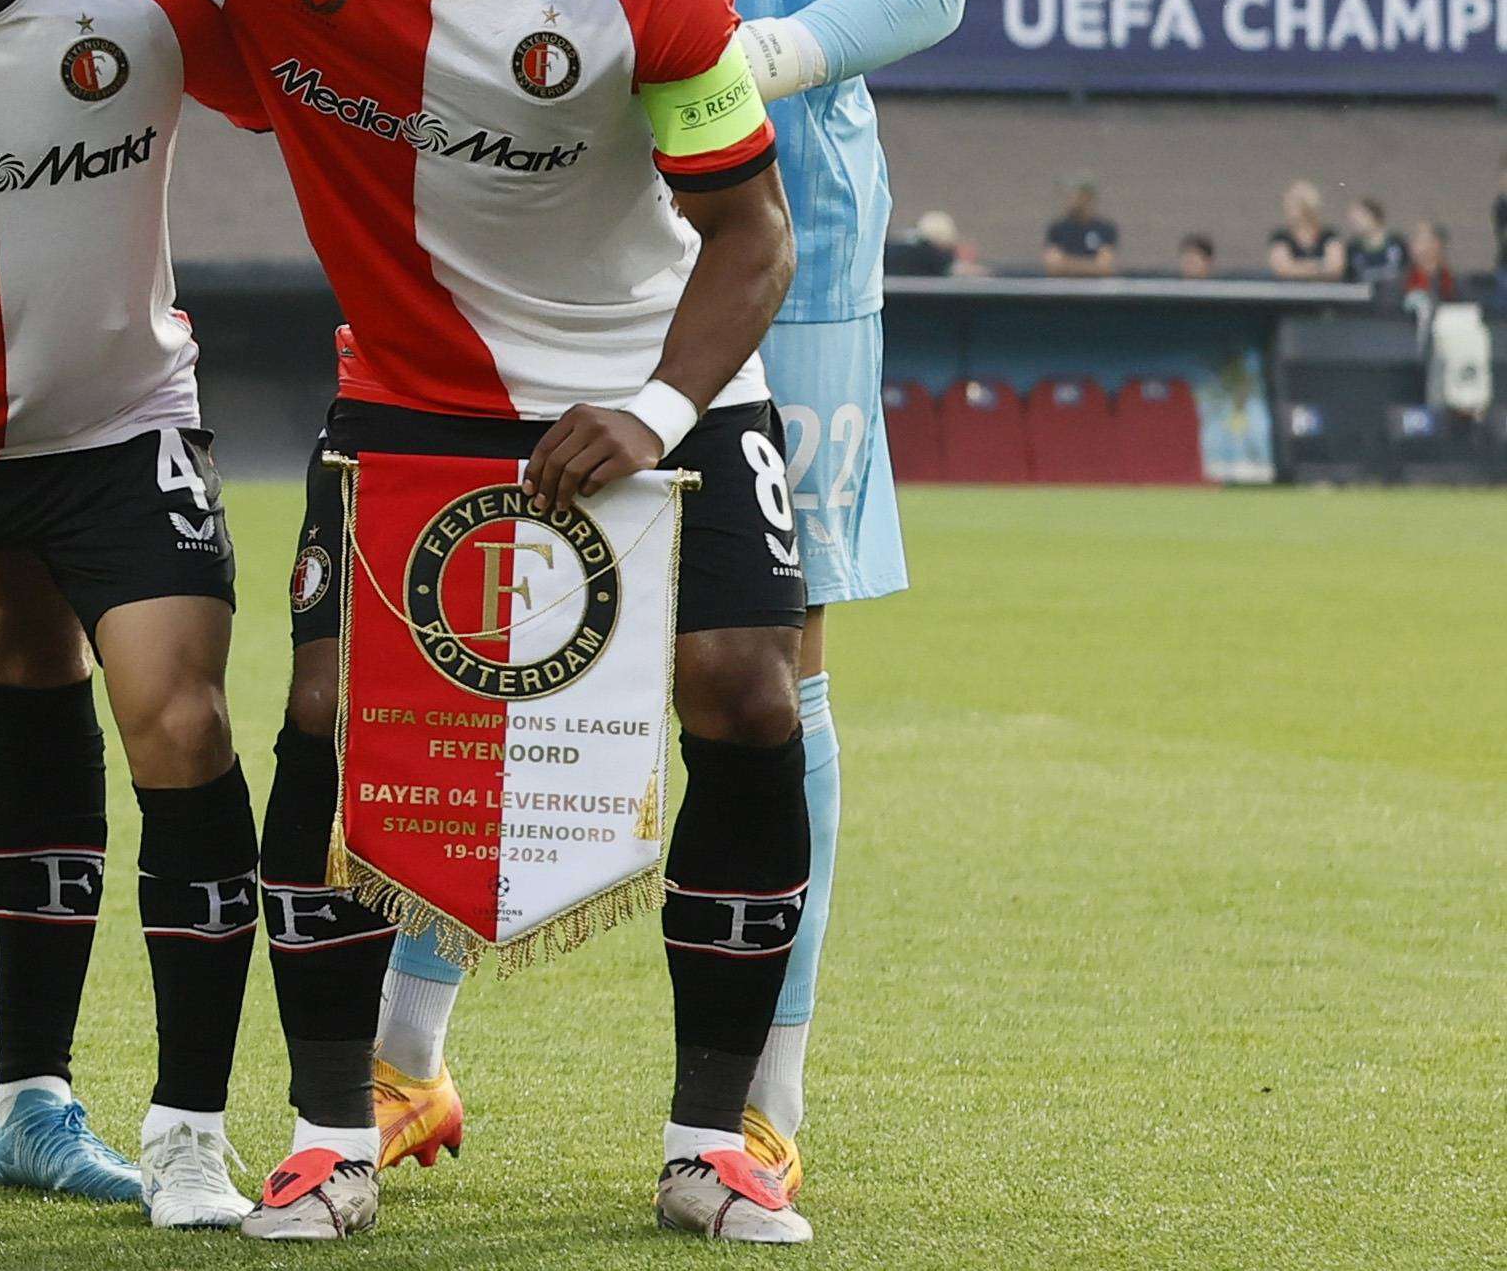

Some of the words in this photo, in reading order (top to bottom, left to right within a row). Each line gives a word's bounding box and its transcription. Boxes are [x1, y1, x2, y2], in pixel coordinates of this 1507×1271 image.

[534, 48, 559, 79] F
[271, 58, 402, 141] Media
[441, 130, 587, 172] Markt
[20, 125, 157, 190] Markt
[157, 427, 209, 510] 4
[741, 431, 793, 531] 8
[778, 403, 865, 509] 22
[424, 493, 605, 563] FEYENOORD
[470, 541, 554, 642] F
[420, 620, 603, 693] ROTTERDAM
[362, 708, 416, 725] UEFA
[425, 710, 556, 733] CHAMPIONS
[565, 718, 650, 737] LEAGUE
[428, 740, 580, 765] FEYENOORD
[360, 783, 440, 806] BAYER
[448, 788, 478, 808] 04
[486, 791, 644, 814] LEVERKUSEN
[383, 817, 476, 837] STADION
[485, 823, 616, 843] FEIJENOORD
[443, 843, 559, 864] 19-09-2024
[30, 855, 103, 914] F
[189, 870, 256, 929] F
[713, 897, 801, 948] F
